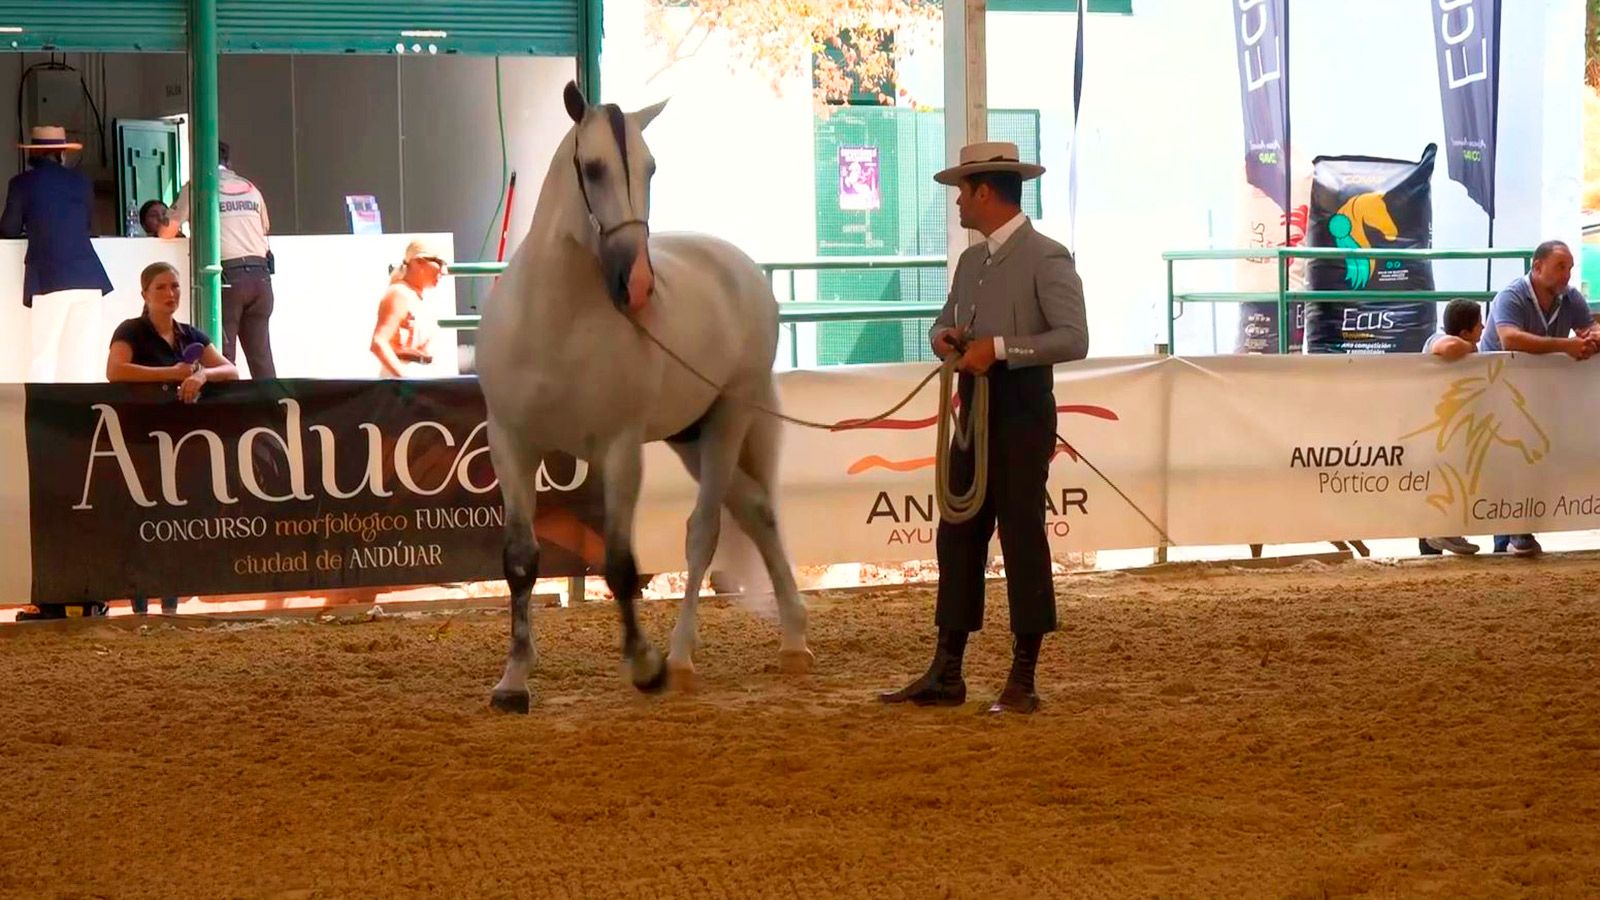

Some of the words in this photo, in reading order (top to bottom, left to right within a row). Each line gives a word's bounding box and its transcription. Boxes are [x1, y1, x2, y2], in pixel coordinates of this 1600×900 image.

[219, 200, 260, 213] EGURID
[1290, 440, 1405, 468] ANDÚJAR
[1319, 471, 1389, 494] Pórtico
[1399, 471, 1430, 491] del
[1473, 497, 1546, 520] Caballo
[139, 516, 267, 543] CONCURSO
[275, 511, 408, 543] morfológico
[416, 505, 507, 530] FUNCION
[234, 550, 308, 576] ciudad
[316, 547, 342, 571] de
[349, 541, 443, 568] ANDÚJAR
